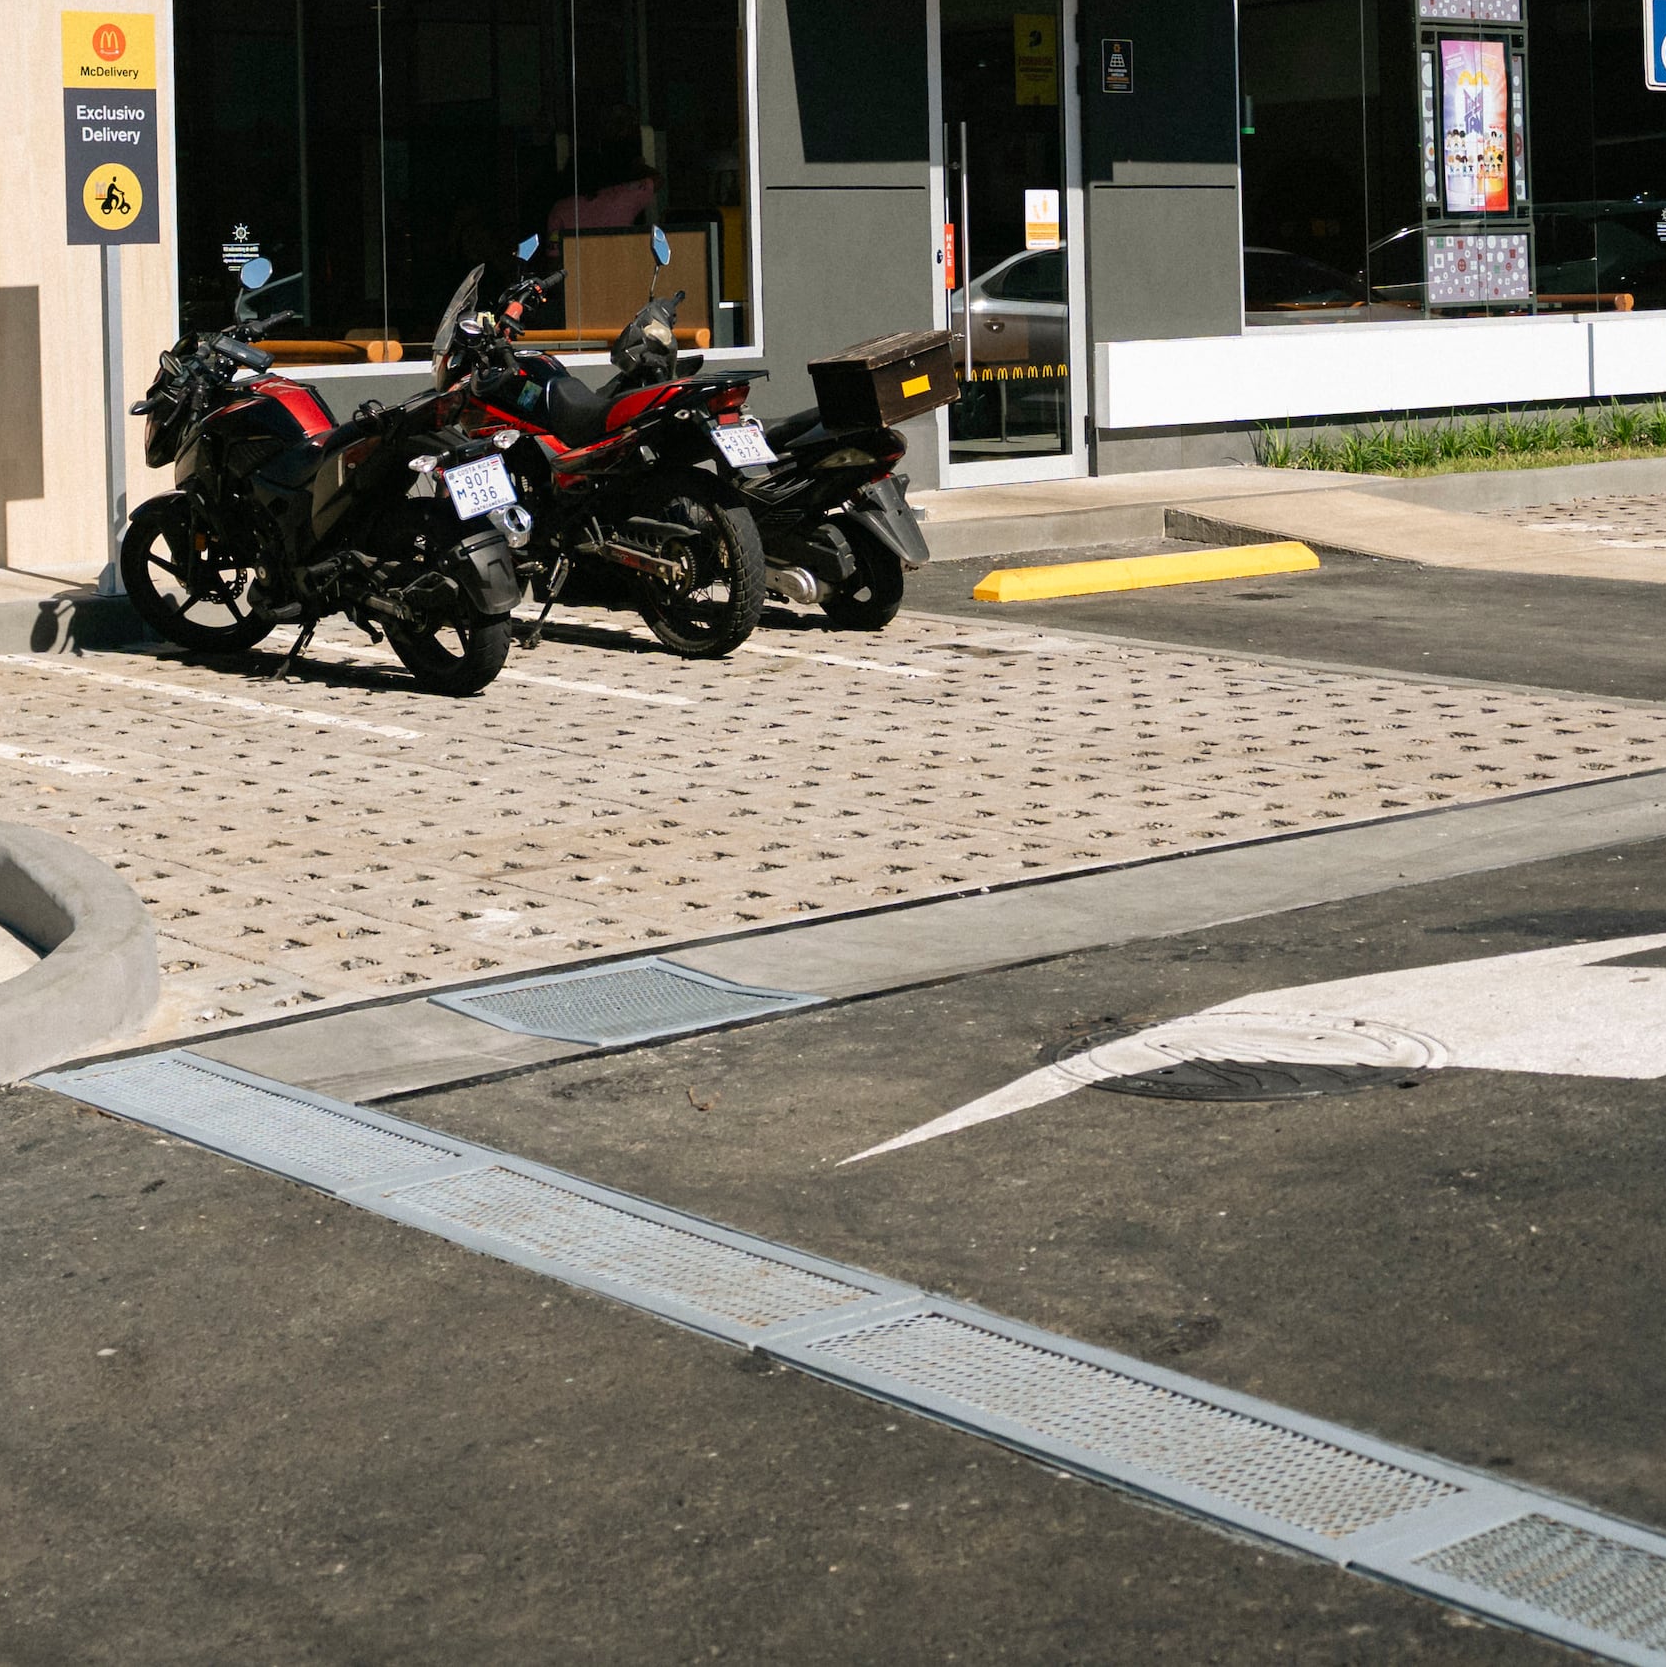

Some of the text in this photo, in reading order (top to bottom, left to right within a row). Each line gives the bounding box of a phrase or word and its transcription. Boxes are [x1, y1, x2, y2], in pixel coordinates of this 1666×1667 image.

[80, 65, 139, 80] McDelivery
[76, 104, 146, 121] Exclusivo
[81, 126, 141, 146] Delivery
[464, 469, 490, 489] 907
[456, 485, 498, 506] M 336
